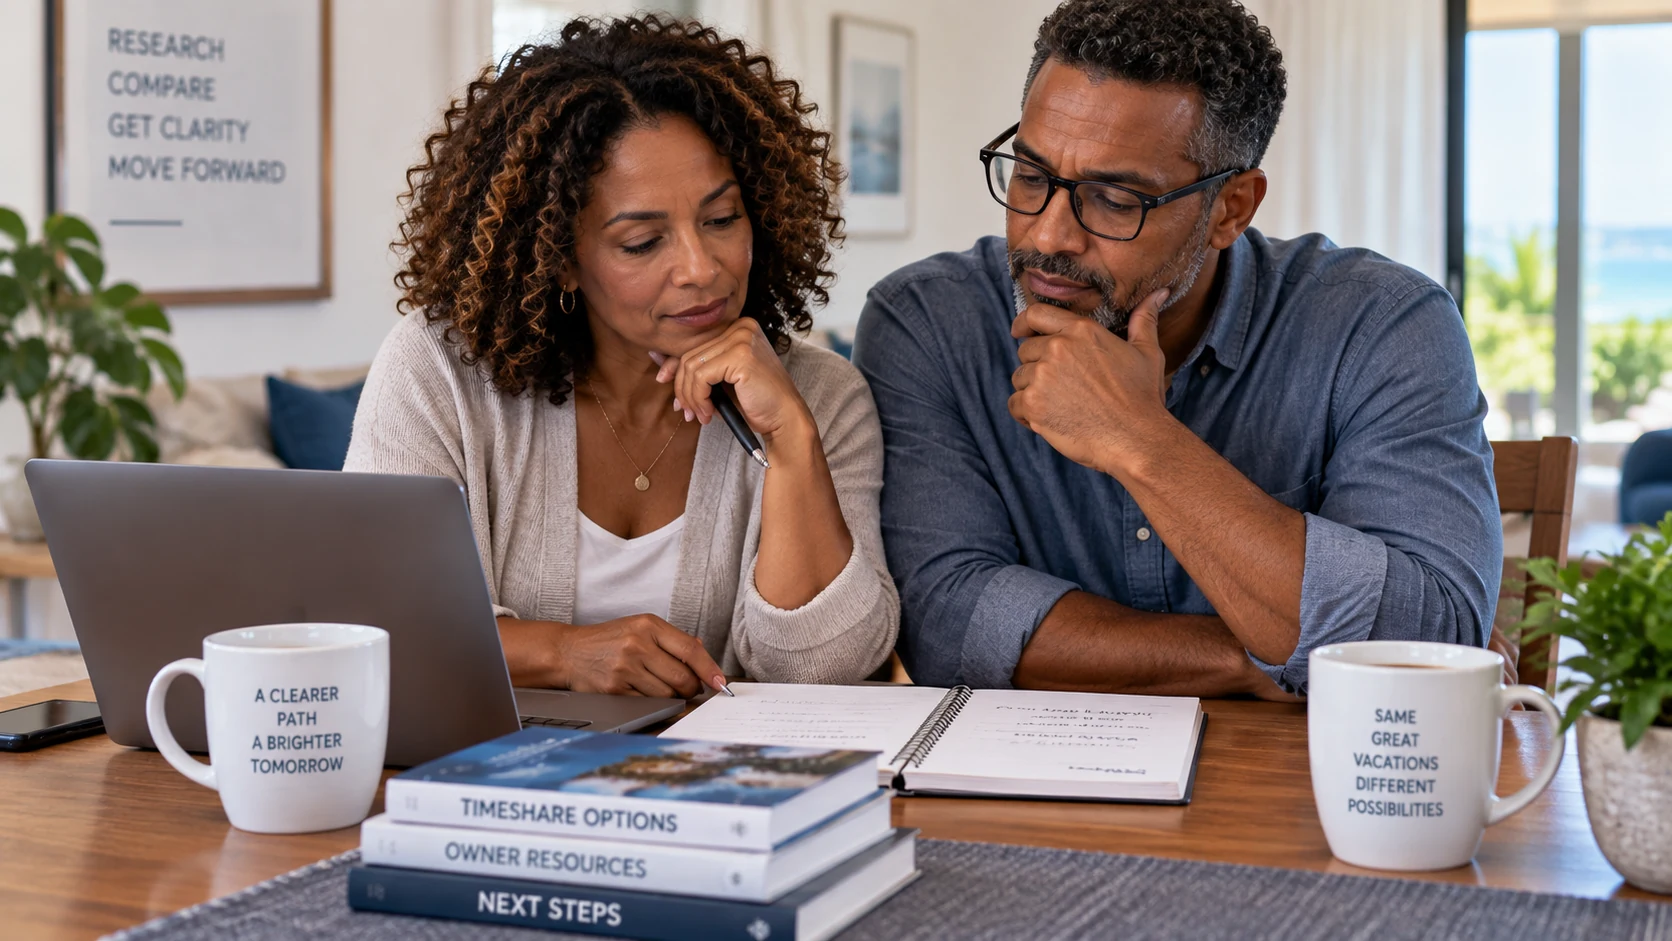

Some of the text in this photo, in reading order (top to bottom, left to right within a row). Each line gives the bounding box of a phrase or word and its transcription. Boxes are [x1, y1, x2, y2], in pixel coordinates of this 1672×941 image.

[108, 26, 225, 62] RESEARCH
[107, 70, 216, 102] COMPARE
[107, 112, 251, 142] GET CLARITY
[108, 155, 287, 184] MOVE FORWARD
[255, 686, 338, 703] A CLEARER
[277, 711, 317, 727] PATH
[1374, 708, 1417, 725] SAME
[252, 733, 341, 750] A BRIGHTER
[1371, 730, 1420, 747] GREAT
[251, 757, 343, 774] TOMORROW
[1354, 753, 1439, 771] VACATIONS
[1357, 776, 1436, 794] DIFFERENT
[461, 798, 678, 834] TIMESHARE OPTIONS
[1347, 798, 1444, 818] POSSIBILITIES
[445, 842, 647, 879] OWNER RESOURCES
[478, 890, 621, 926] NEXT STEPS
